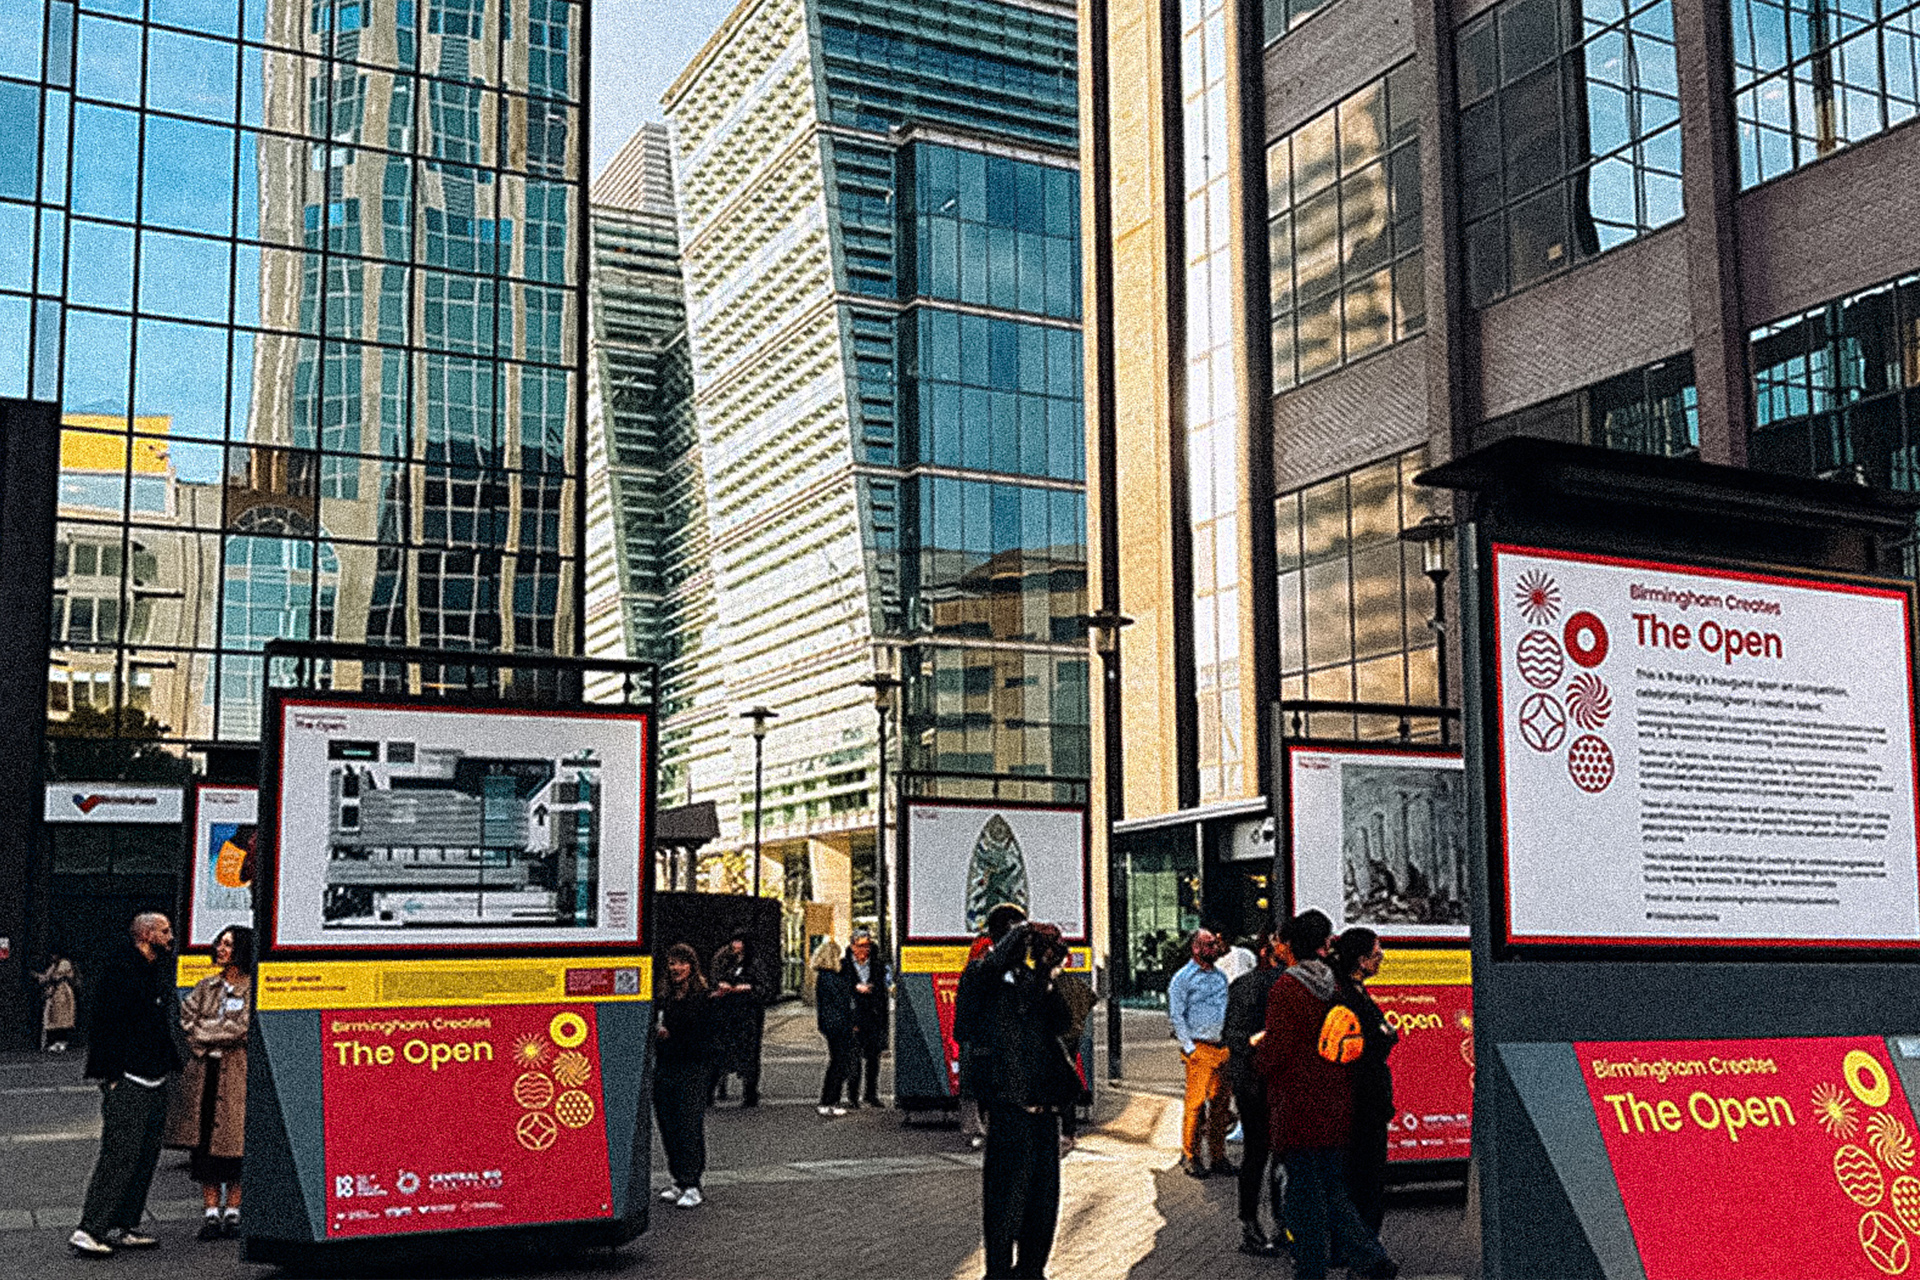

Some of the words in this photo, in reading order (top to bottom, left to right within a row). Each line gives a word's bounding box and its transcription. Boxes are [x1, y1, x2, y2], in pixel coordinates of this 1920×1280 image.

[1630, 583, 1723, 611] Birmingham
[1726, 594, 1782, 616] Creates
[1632, 613, 1692, 650] The
[1698, 620, 1783, 665] Open
[331, 1018, 430, 1037] Birmingham
[432, 1016, 492, 1031] Creates
[1384, 1009, 1443, 1036] Open
[333, 1041, 395, 1066] The
[403, 1038, 494, 1072] Open
[1592, 1057, 1708, 1083] Birmingham
[1709, 1056, 1778, 1076] Creates
[1603, 1092, 1683, 1134] The
[1688, 1091, 1797, 1143] Open
